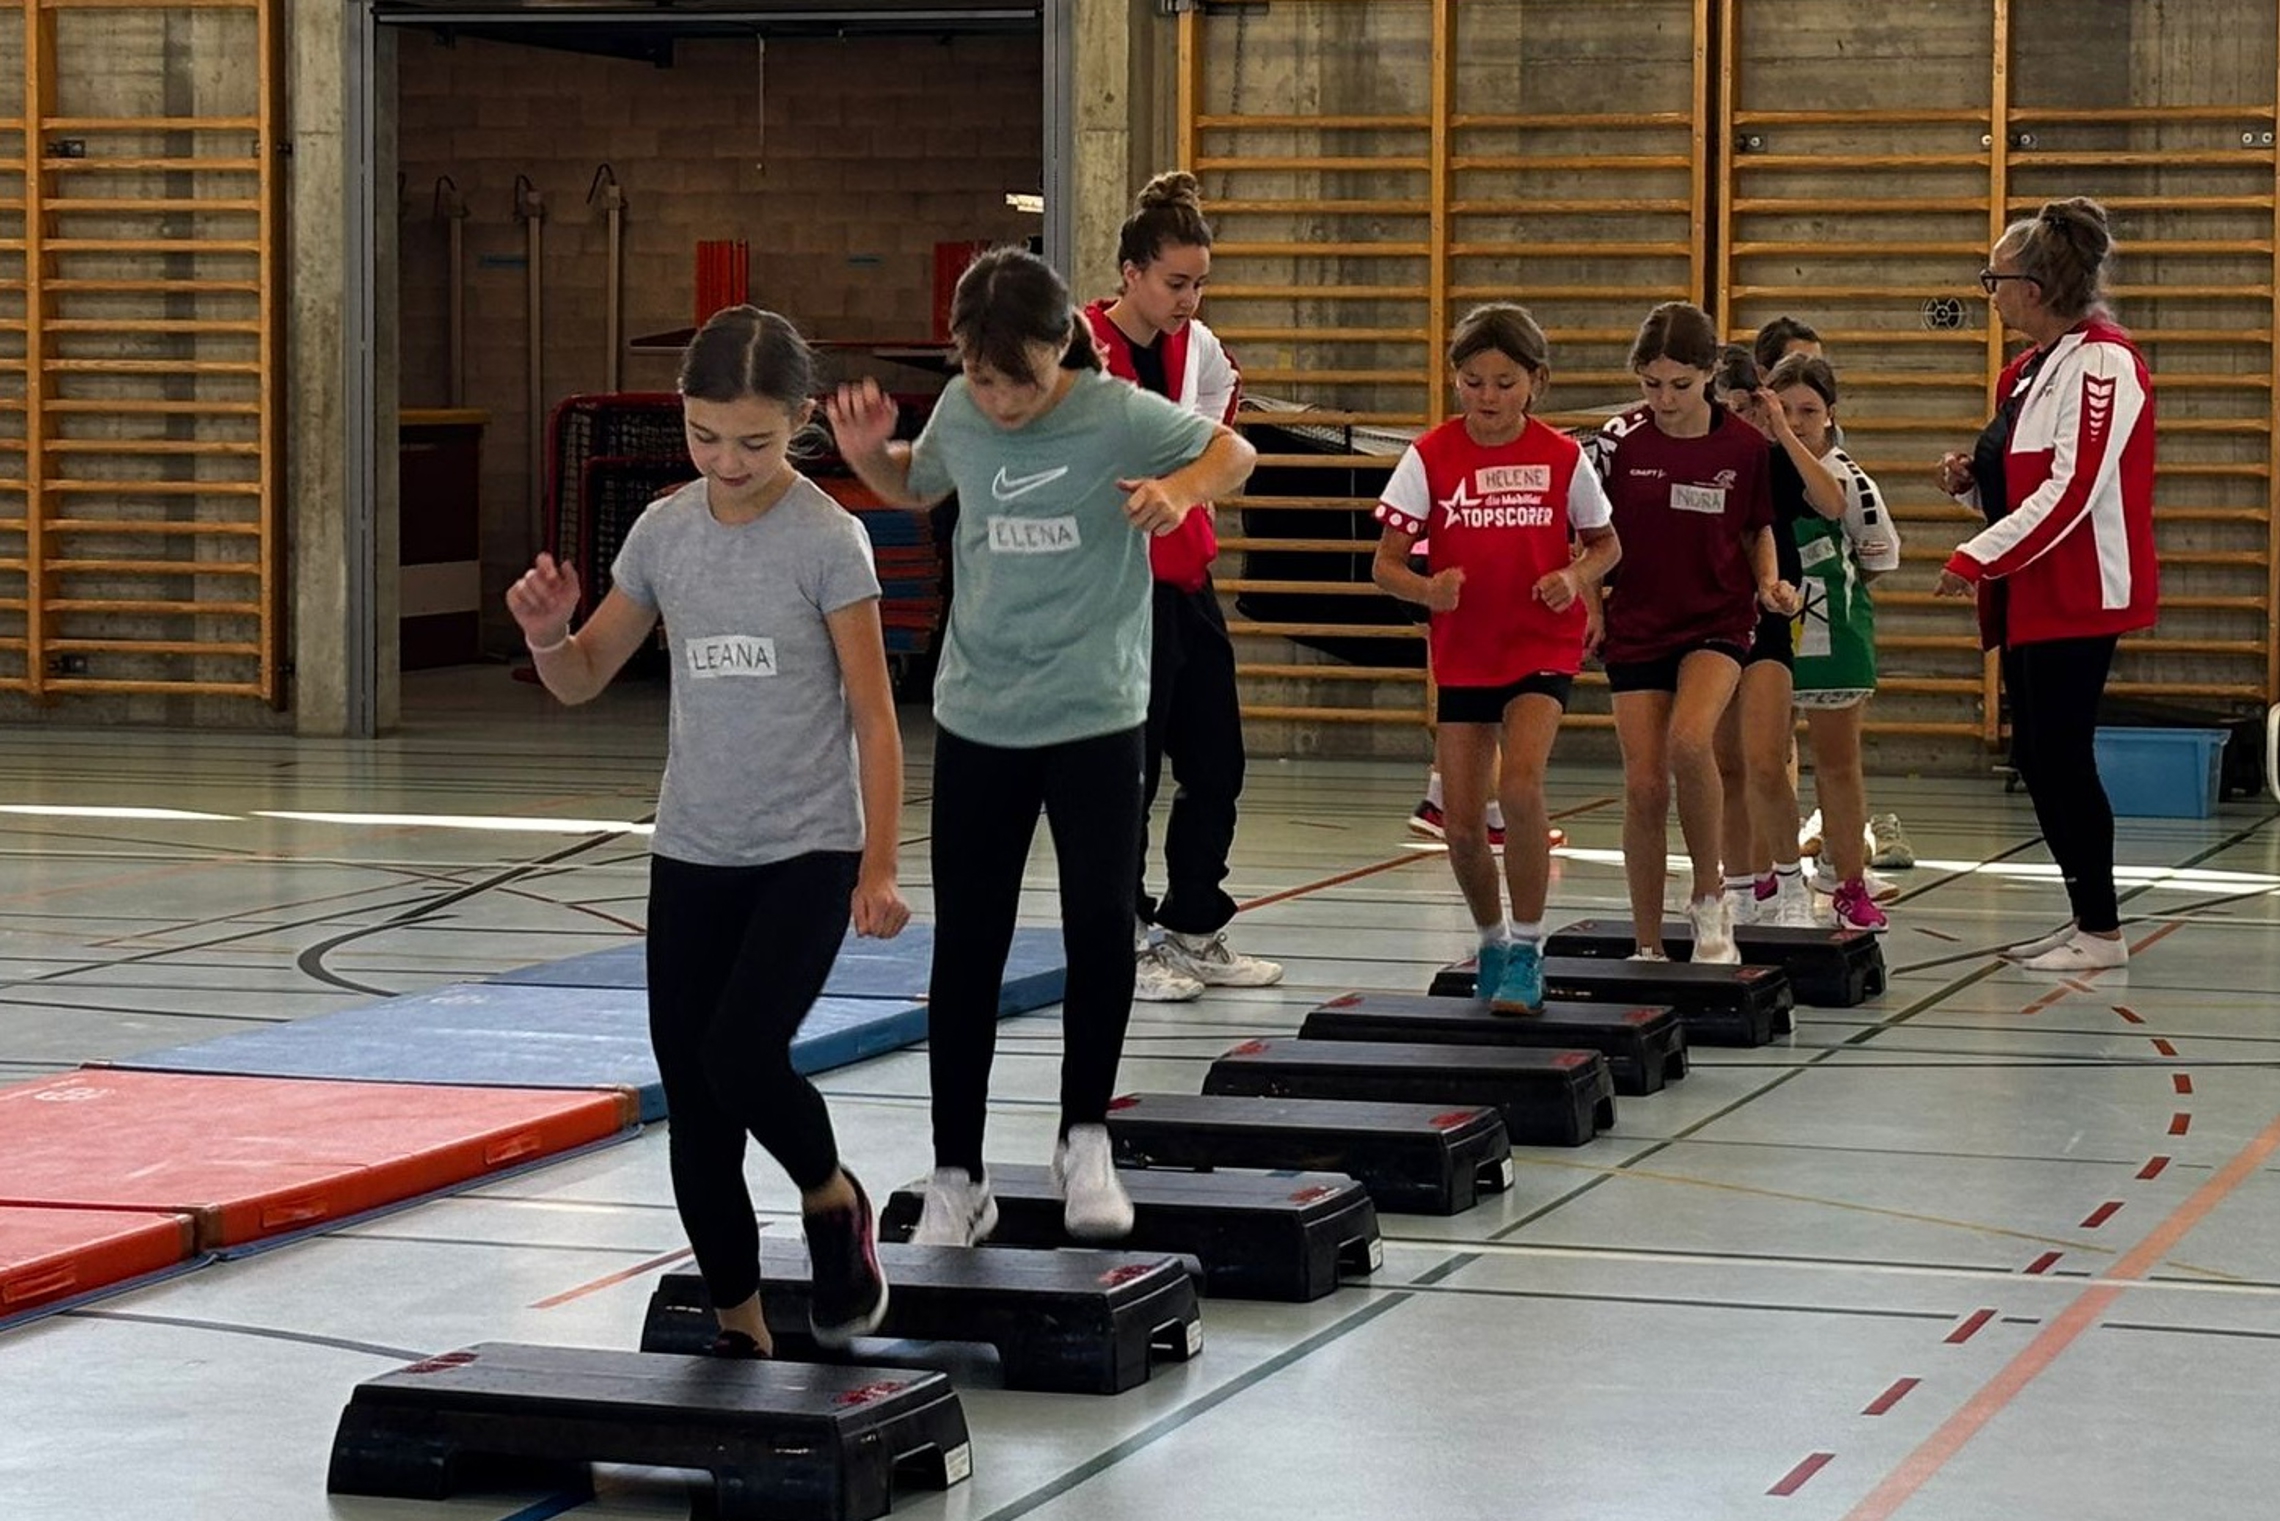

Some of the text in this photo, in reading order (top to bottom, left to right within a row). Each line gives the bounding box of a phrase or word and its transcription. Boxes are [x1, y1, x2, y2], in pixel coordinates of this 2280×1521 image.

[1485, 468, 1543, 488] HELENE
[1676, 487, 1722, 510] NORA
[1461, 506, 1554, 528] TOPSCORER
[995, 521, 1073, 548] ELENA
[692, 643, 771, 670] LEANA
